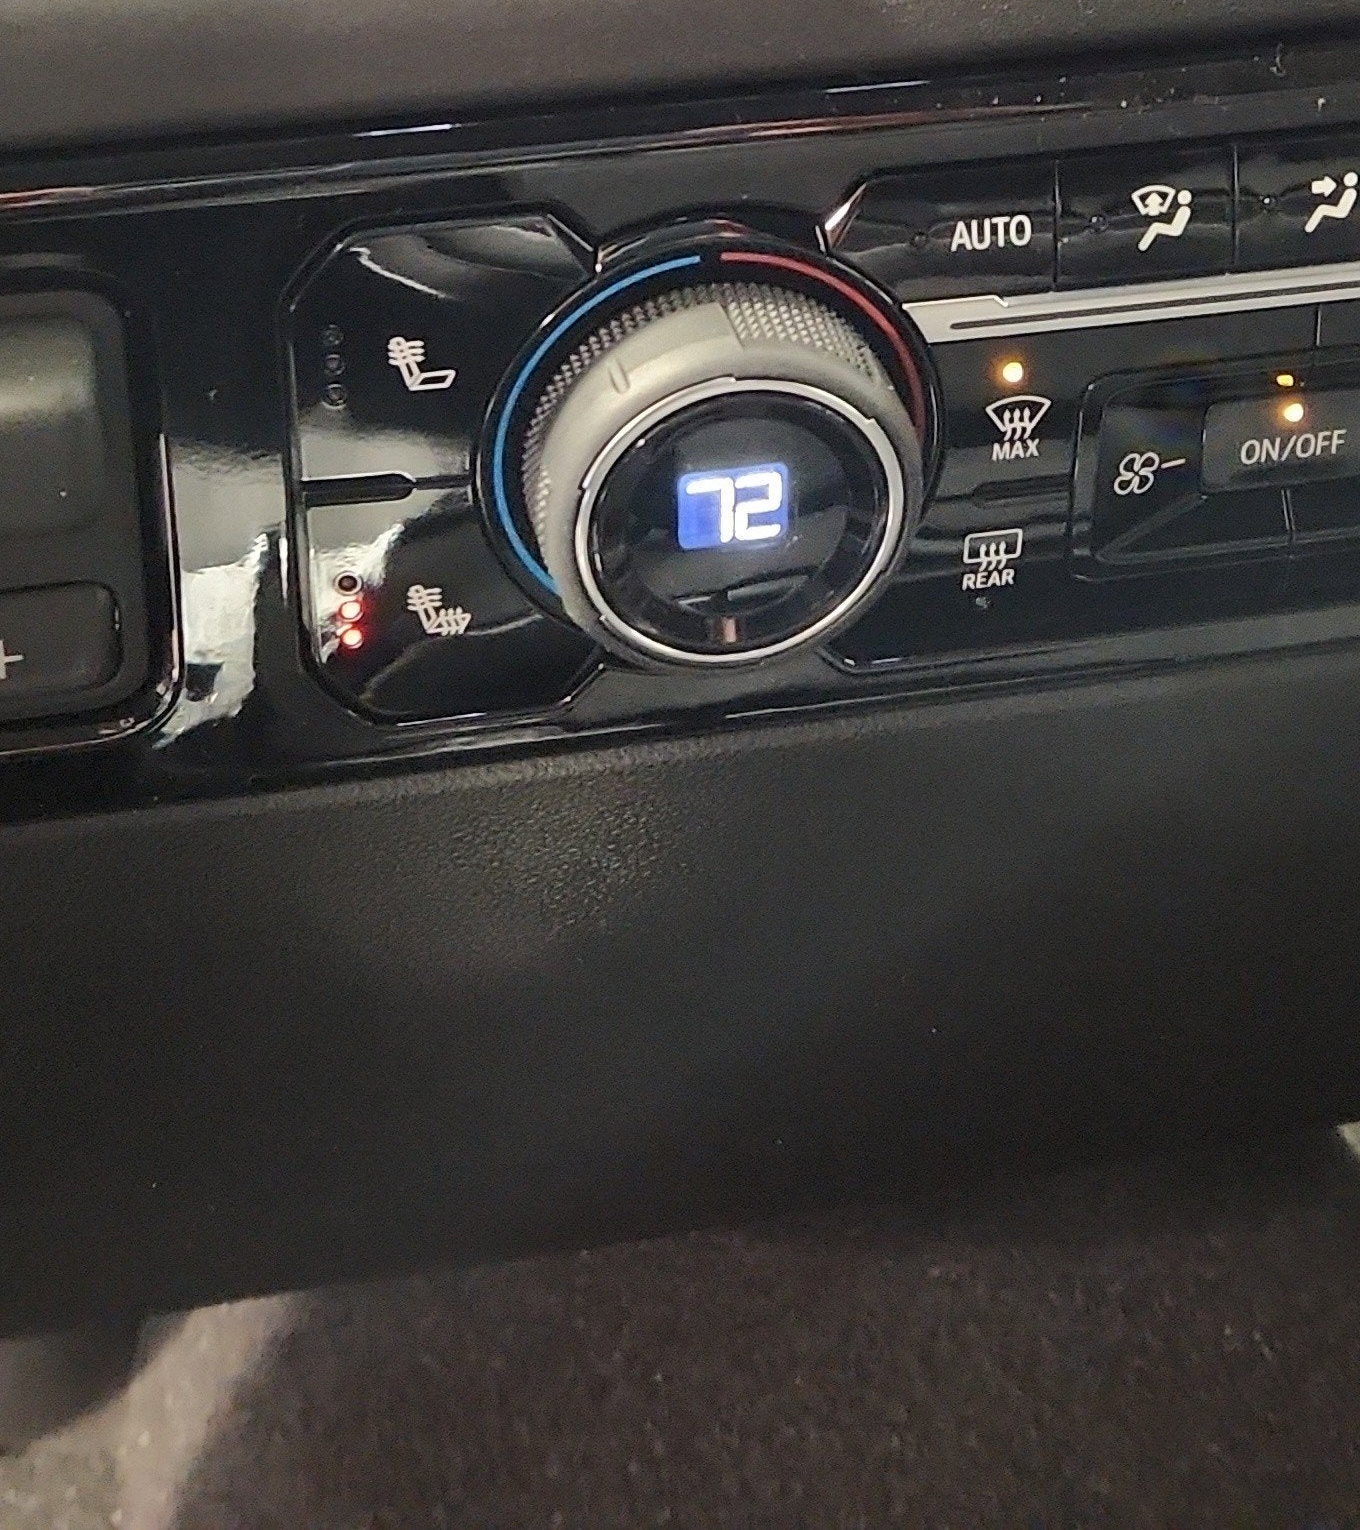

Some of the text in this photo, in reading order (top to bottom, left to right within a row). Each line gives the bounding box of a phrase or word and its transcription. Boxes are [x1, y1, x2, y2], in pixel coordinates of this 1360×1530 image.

[951, 214, 1032, 252] AUTO
[992, 438, 1040, 460] MAX
[1240, 430, 1347, 465] ON/OFF
[685, 471, 783, 544] 72
[962, 568, 1015, 590] REAR
